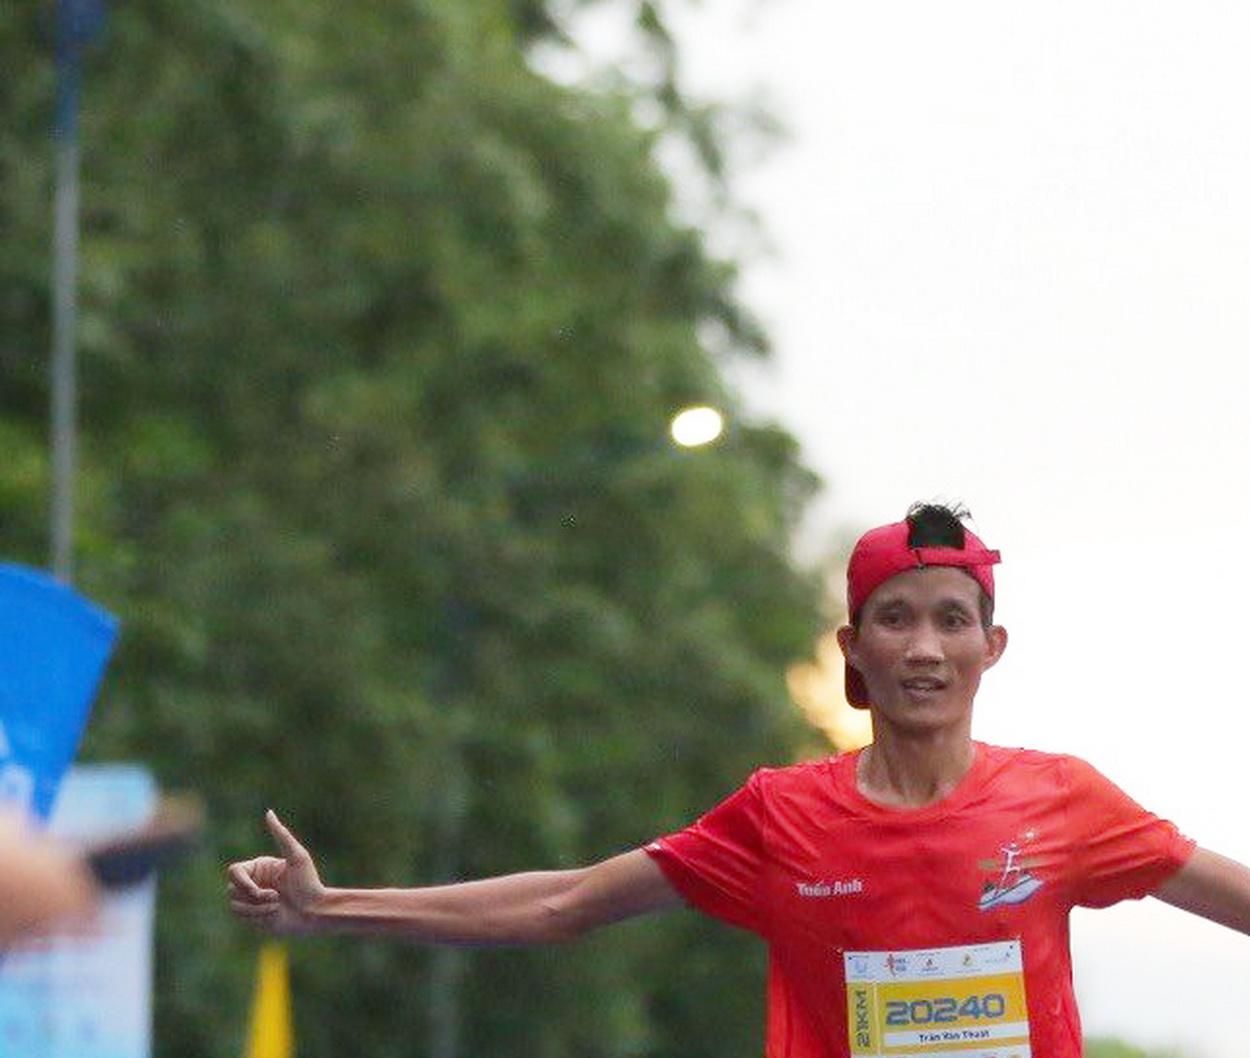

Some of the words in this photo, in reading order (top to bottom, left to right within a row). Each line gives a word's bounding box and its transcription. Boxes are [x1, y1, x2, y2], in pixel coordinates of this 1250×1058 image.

[833, 879, 863, 896] Anh
[855, 989, 871, 1048] 21KM
[885, 994, 1006, 1026] 20240
